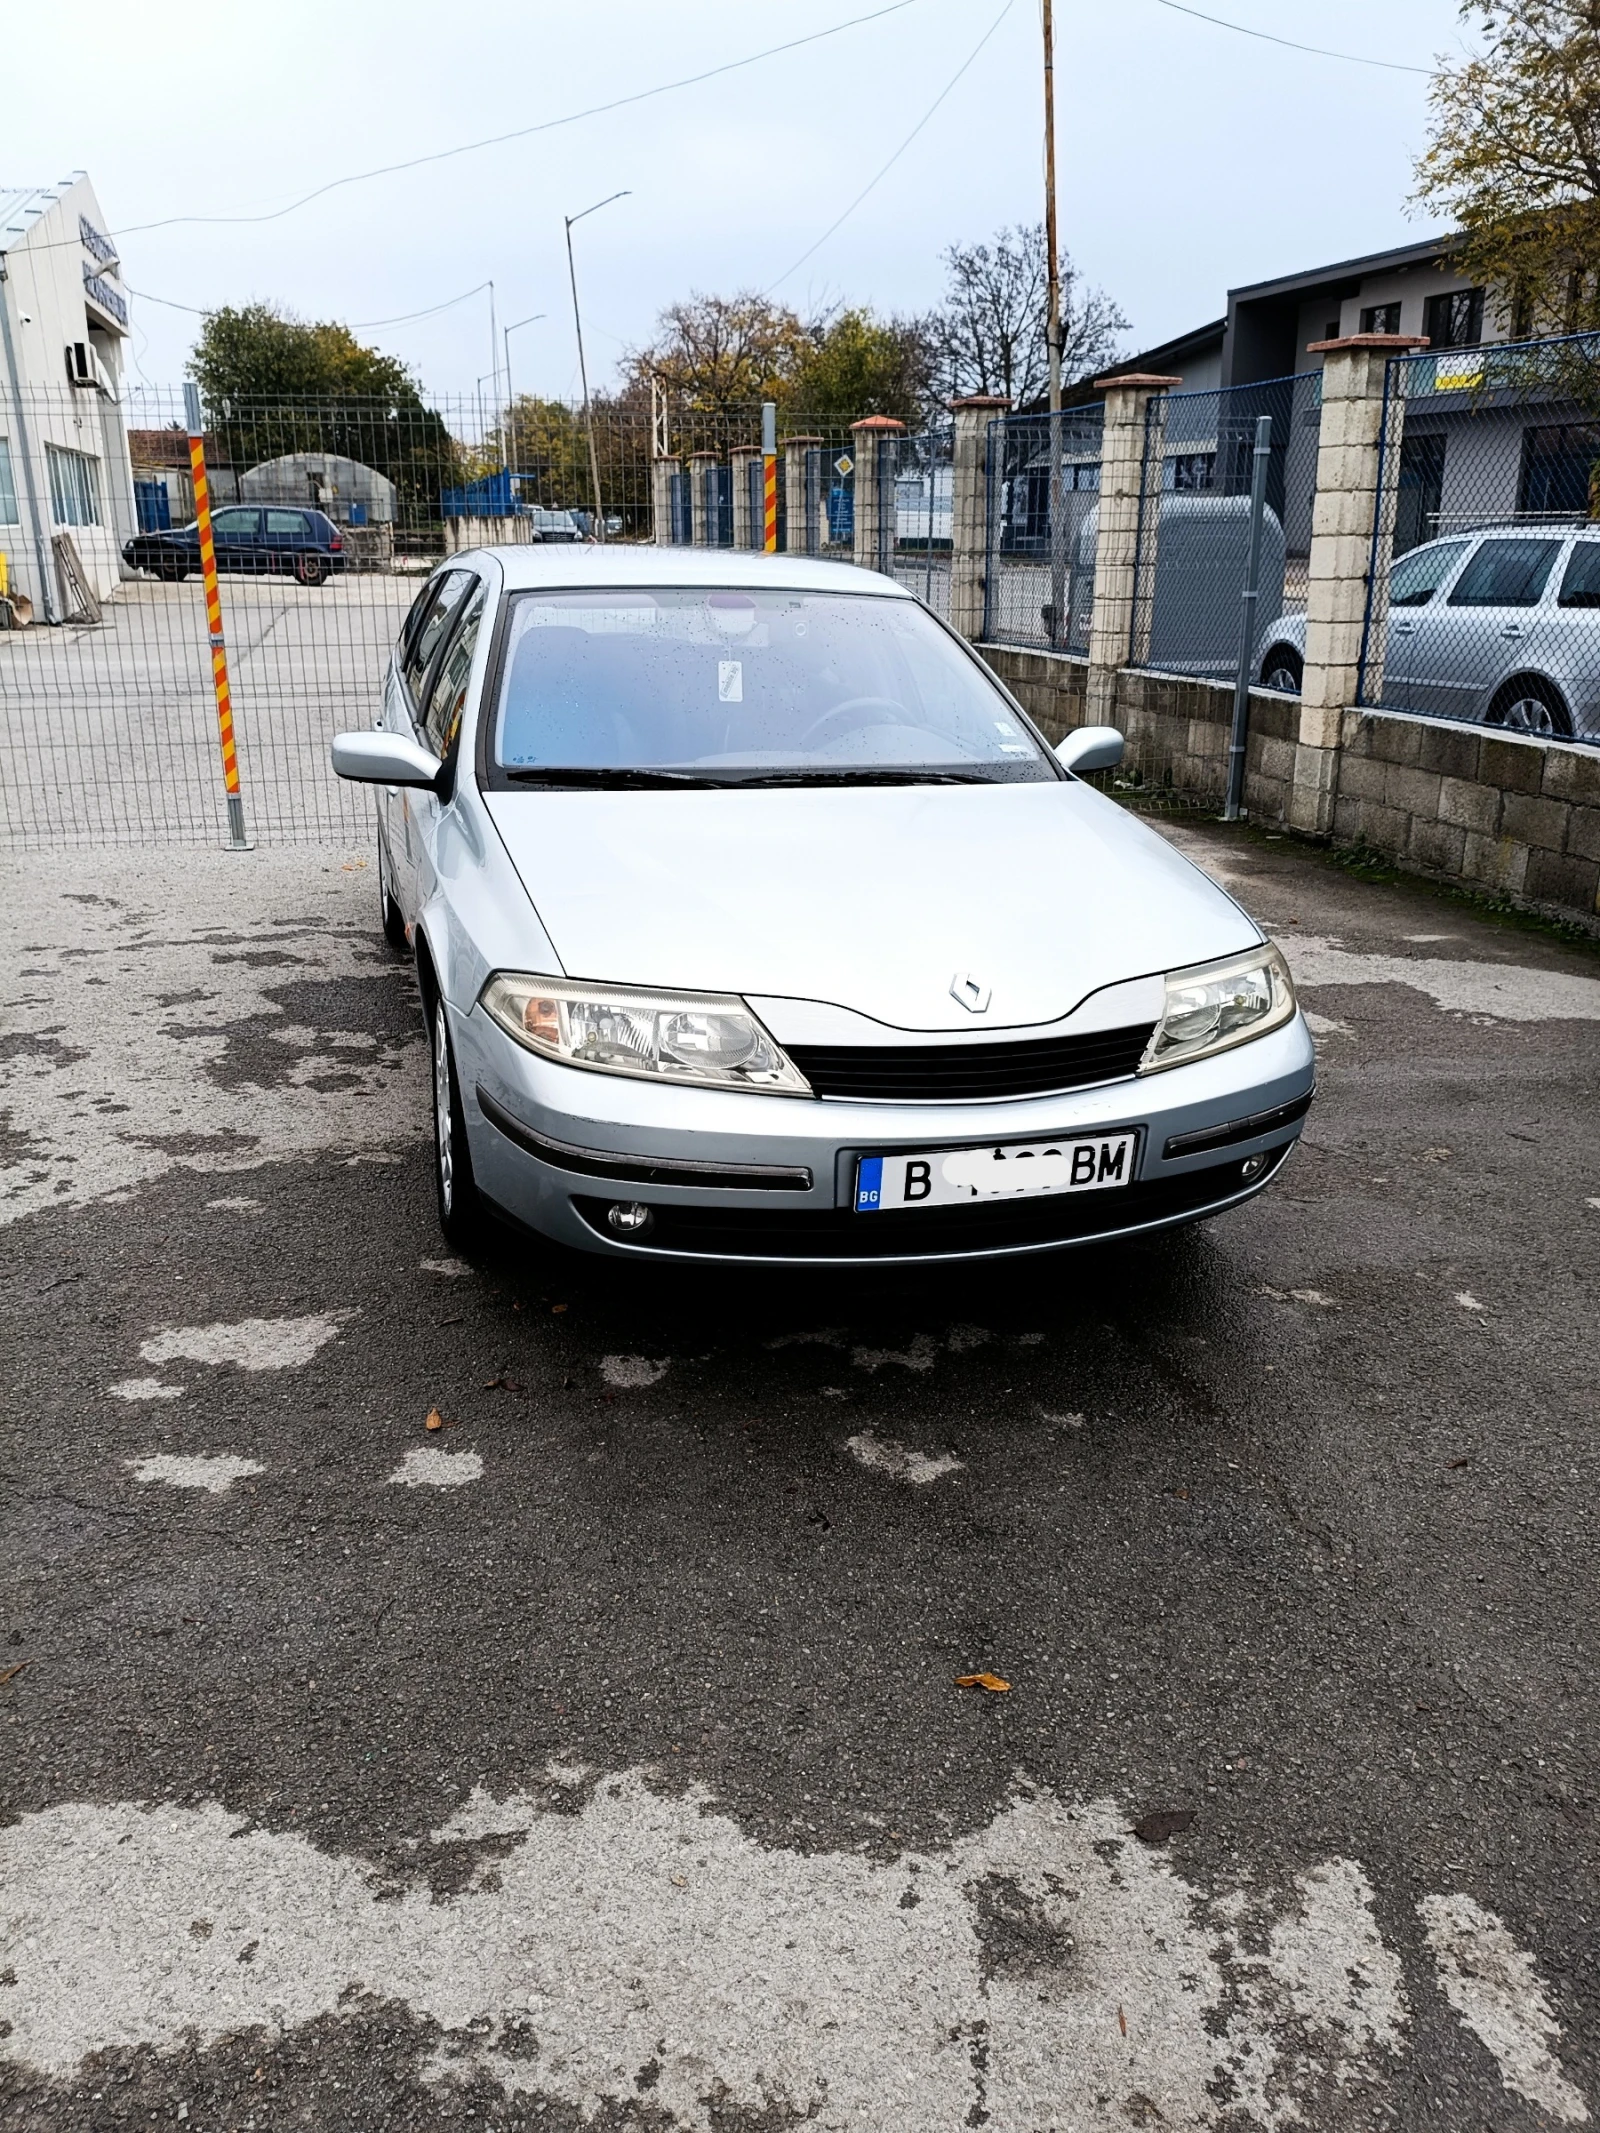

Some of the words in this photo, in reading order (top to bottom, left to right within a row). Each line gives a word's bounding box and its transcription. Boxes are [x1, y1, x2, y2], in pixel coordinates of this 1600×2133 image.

[904, 1160, 931, 1201] B
[1070, 1140, 1127, 1186] BM
[859, 1190, 878, 1203] BG
